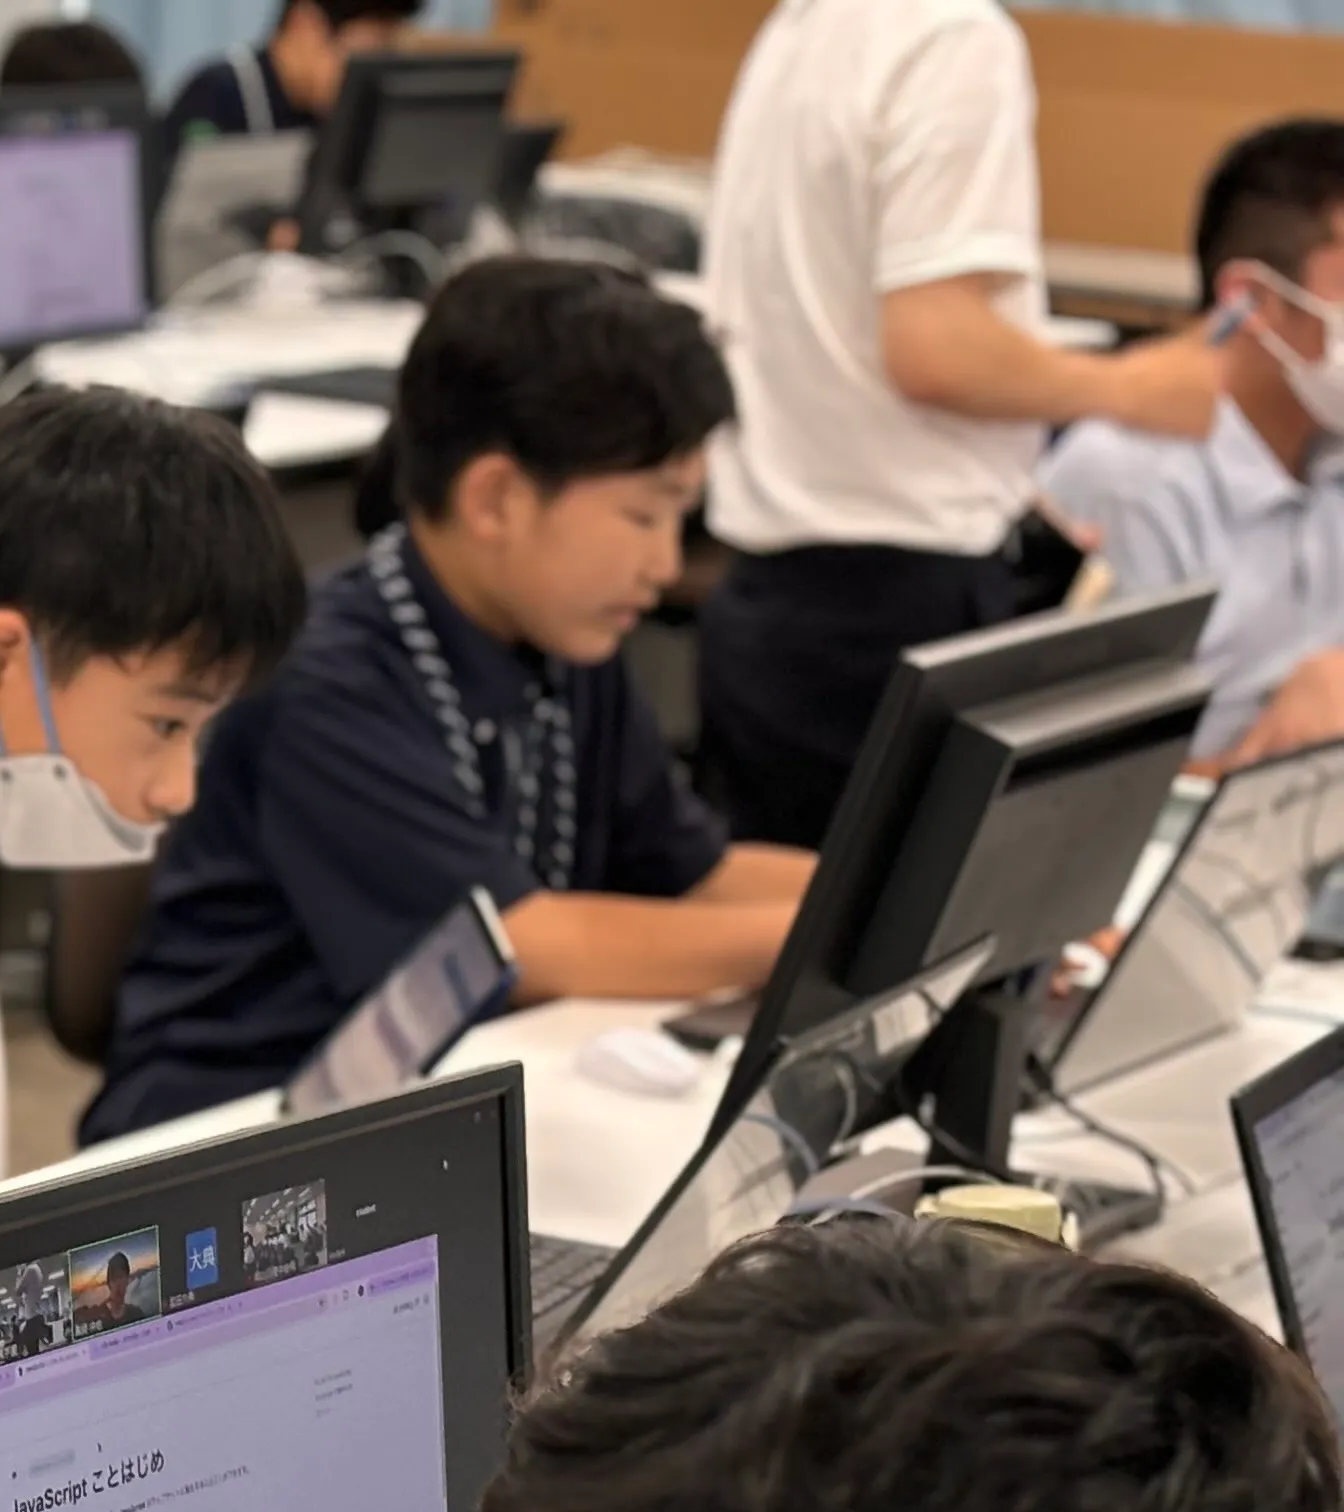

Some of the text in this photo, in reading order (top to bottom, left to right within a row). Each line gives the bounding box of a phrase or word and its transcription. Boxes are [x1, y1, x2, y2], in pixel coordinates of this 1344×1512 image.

[92, 1449, 165, 1493] ことはじめ
